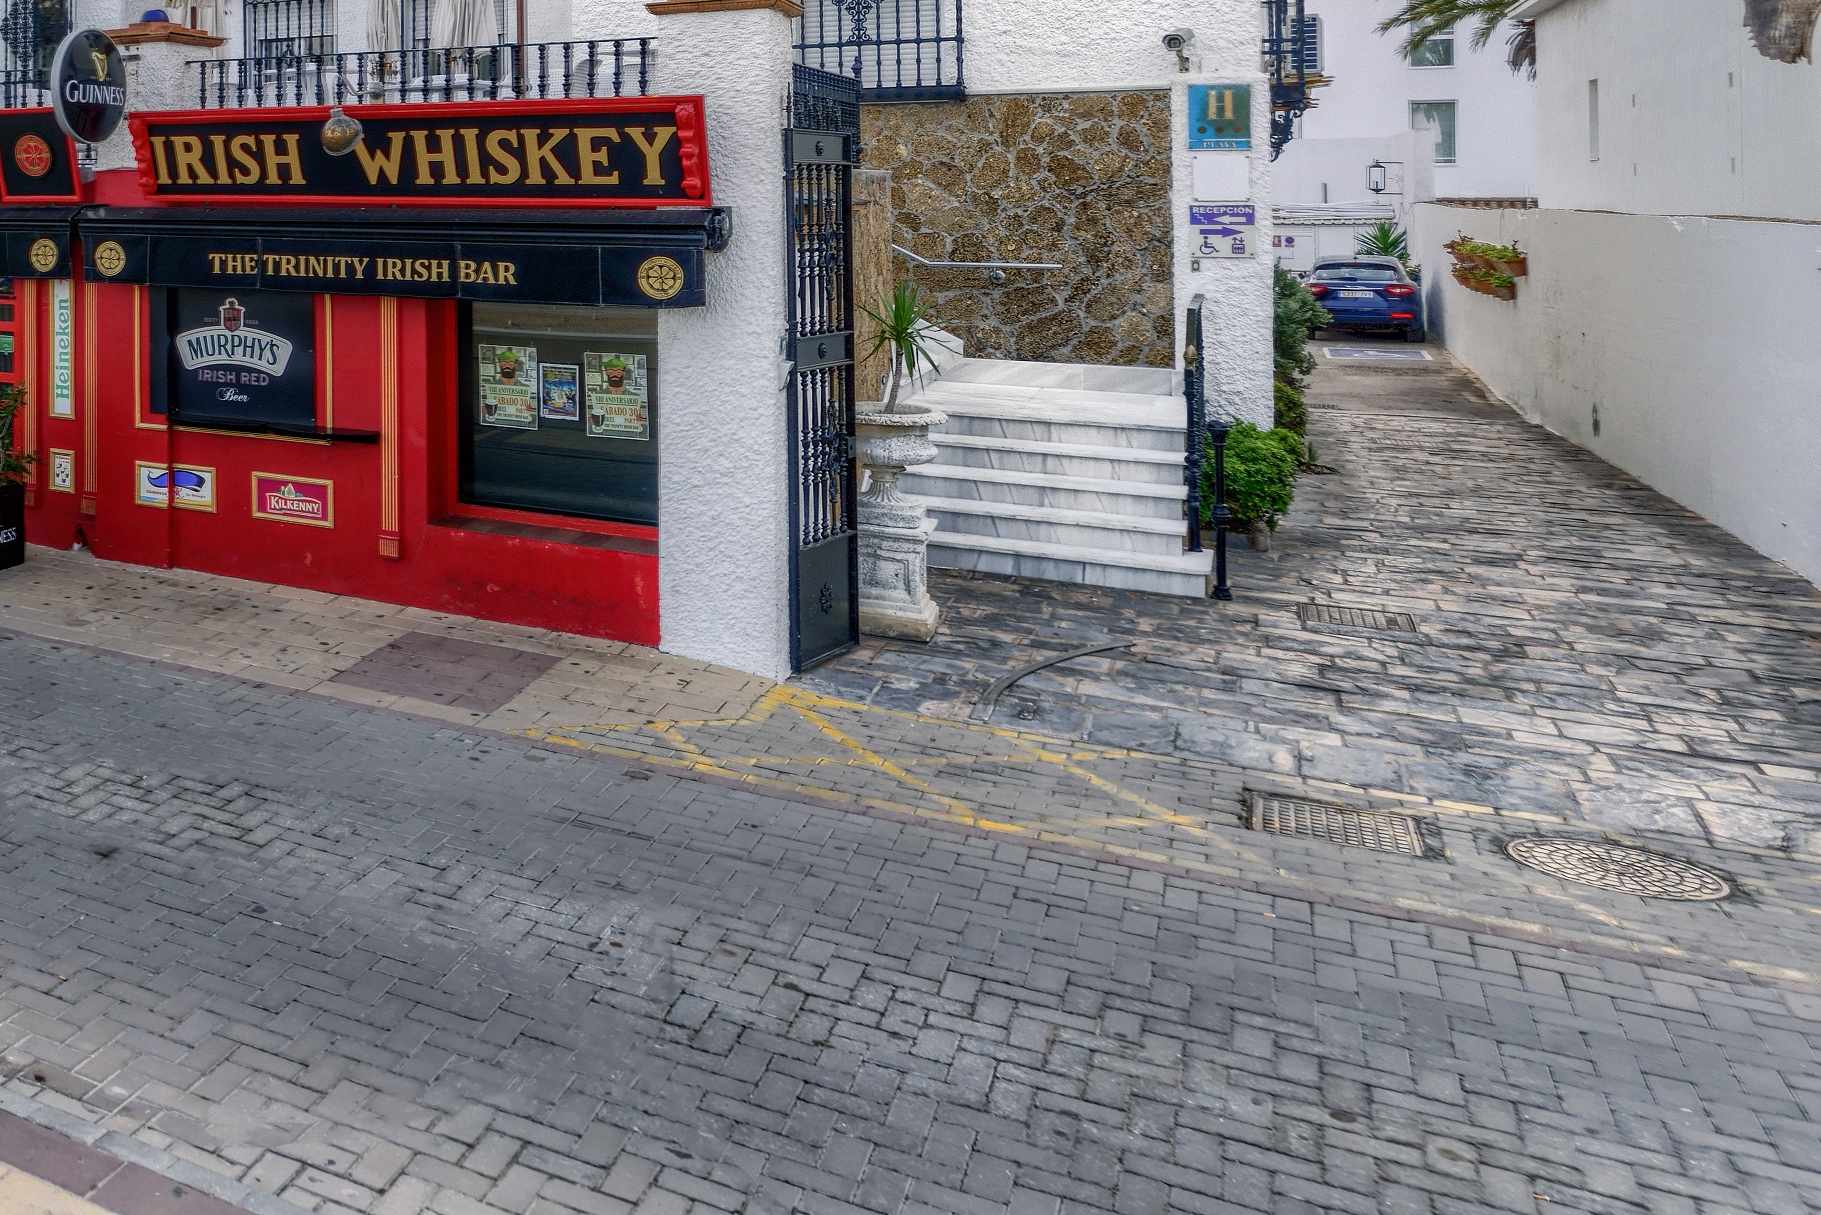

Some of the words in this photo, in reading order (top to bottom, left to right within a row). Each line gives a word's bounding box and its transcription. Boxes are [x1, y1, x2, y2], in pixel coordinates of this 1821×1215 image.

[66, 79, 124, 106] GUINNESS
[1207, 89, 1235, 120] H
[1203, 140, 1237, 148] PLAYA
[149, 134, 307, 185] IRISH
[352, 126, 678, 185] WHISKEY
[1192, 205, 1253, 214] RECEPCIÓN
[208, 253, 258, 275] THE
[264, 254, 369, 280] TRINITY
[375, 258, 451, 283] IRISH
[457, 260, 517, 286] BAR
[55, 297, 70, 401] Heineken
[186, 333, 281, 366] MURPHY'S
[197, 369, 236, 384] IRISH
[240, 371, 269, 386] RED
[216, 387, 251, 403] Beer
[498, 387, 529, 395] ANIVERSARIO
[605, 396, 639, 405] ANIVERSARIO
[628, 407, 639, 417] 30
[270, 495, 320, 513] KILKENNY
